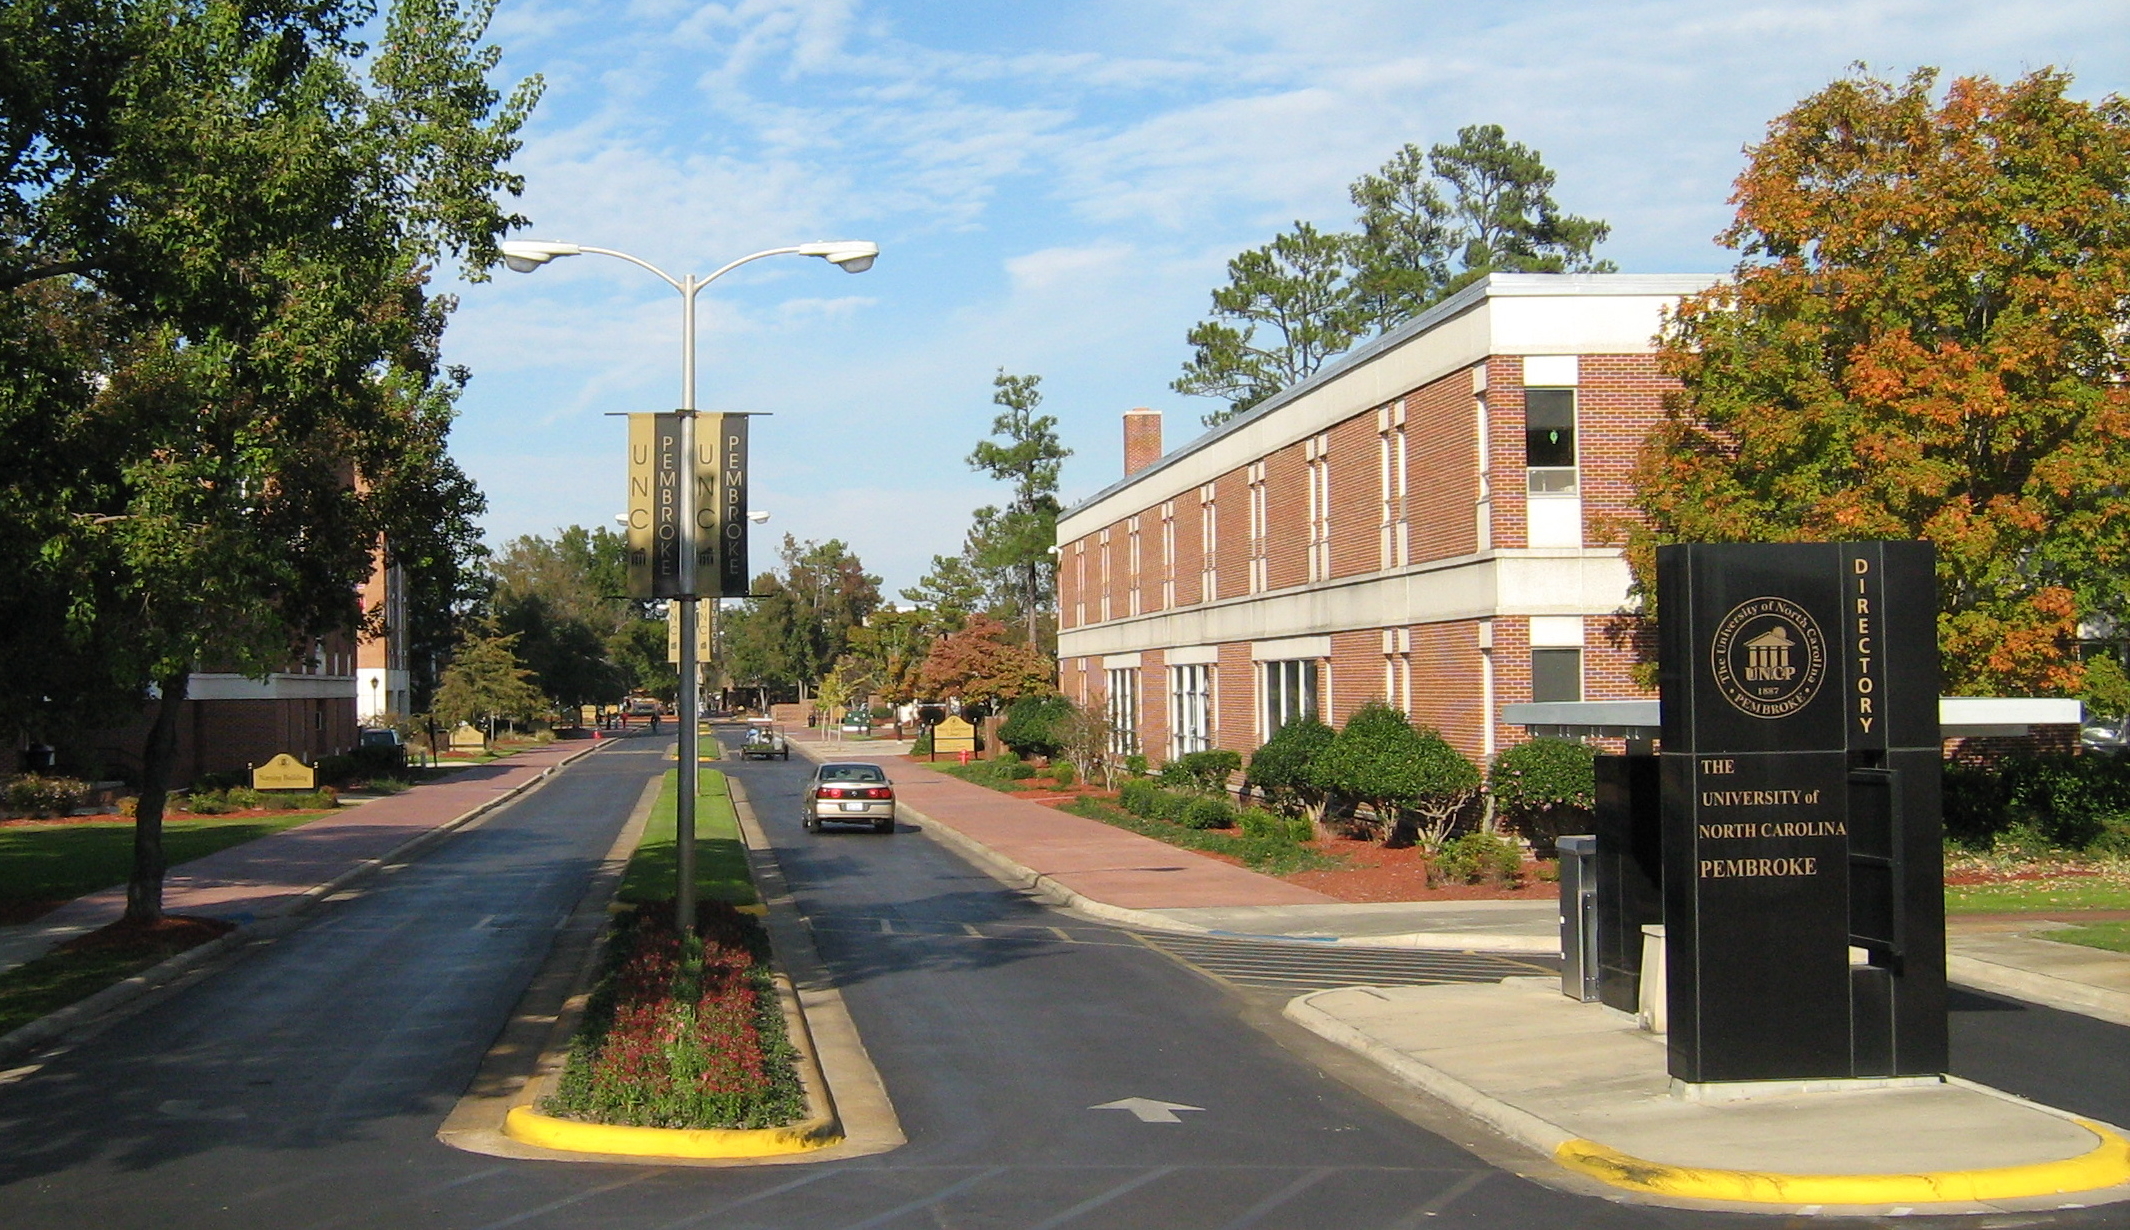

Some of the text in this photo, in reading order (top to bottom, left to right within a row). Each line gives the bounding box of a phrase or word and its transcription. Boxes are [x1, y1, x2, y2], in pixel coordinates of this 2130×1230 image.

[629, 444, 649, 530] UNC
[659, 436, 676, 576] PEMBROKE
[696, 443, 716, 530] UNC
[725, 435, 743, 575] PEMBROKE
[1716, 601, 1823, 684] The University of North Carolina
[1854, 558, 1874, 734] DIRECTORY
[1745, 667, 1796, 681] UNCP
[1734, 693, 1806, 715] PEMBROKE
[1701, 759, 1735, 775] THE
[1702, 789, 1820, 807] UNIVERSITY of
[1699, 821, 1847, 839] NORTH CAROLINA
[1701, 857, 1817, 878] PEMBROKE
